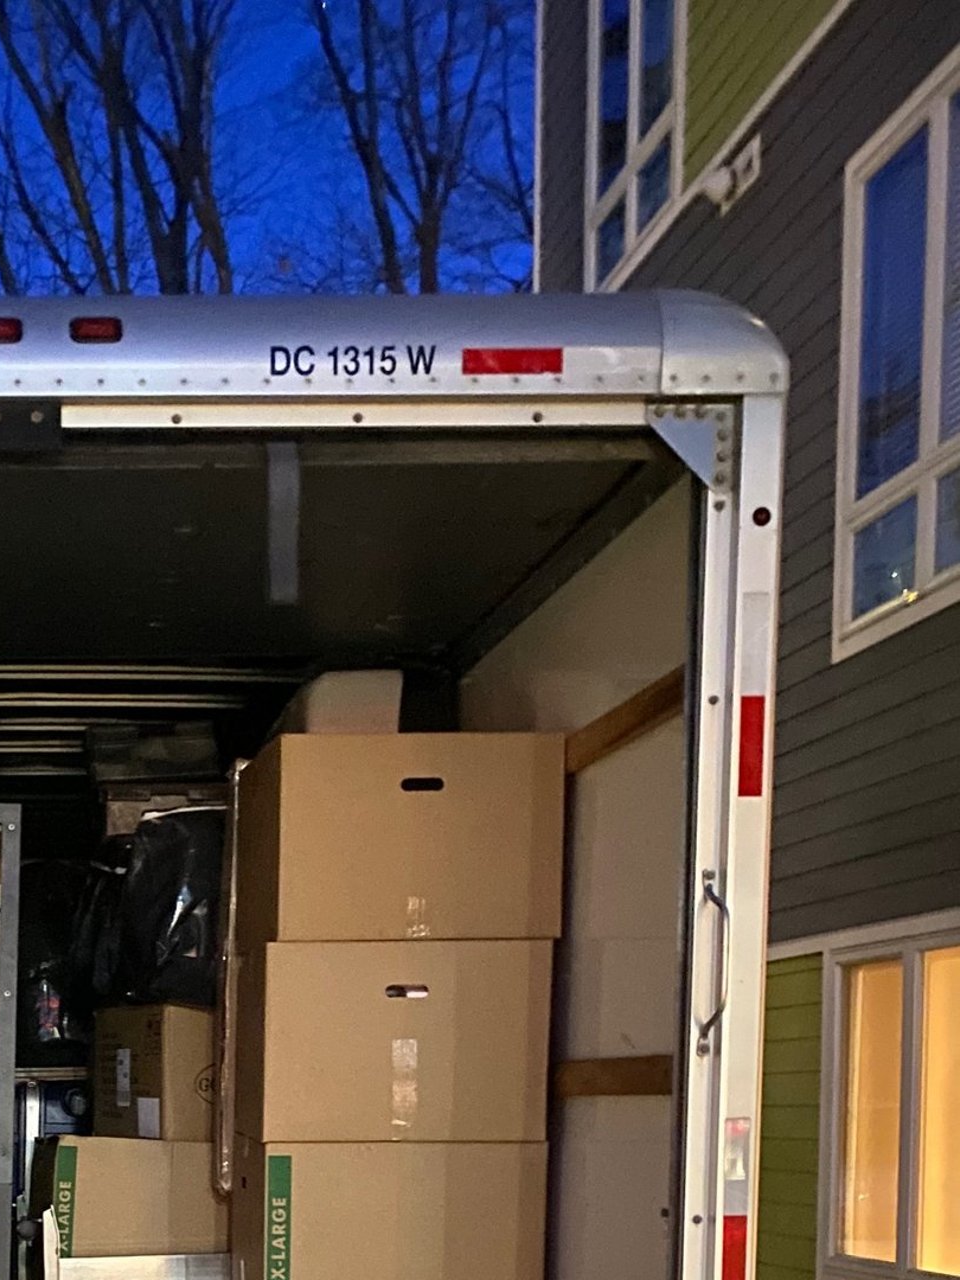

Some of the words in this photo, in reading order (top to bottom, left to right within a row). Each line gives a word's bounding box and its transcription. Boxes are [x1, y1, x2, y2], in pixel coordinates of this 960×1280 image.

[270, 346, 315, 376] DC
[328, 346, 397, 376] 1315
[407, 345, 436, 376] W
[58, 1180, 72, 1252] X-LARGE
[271, 1197, 287, 1280] X-LARGE
